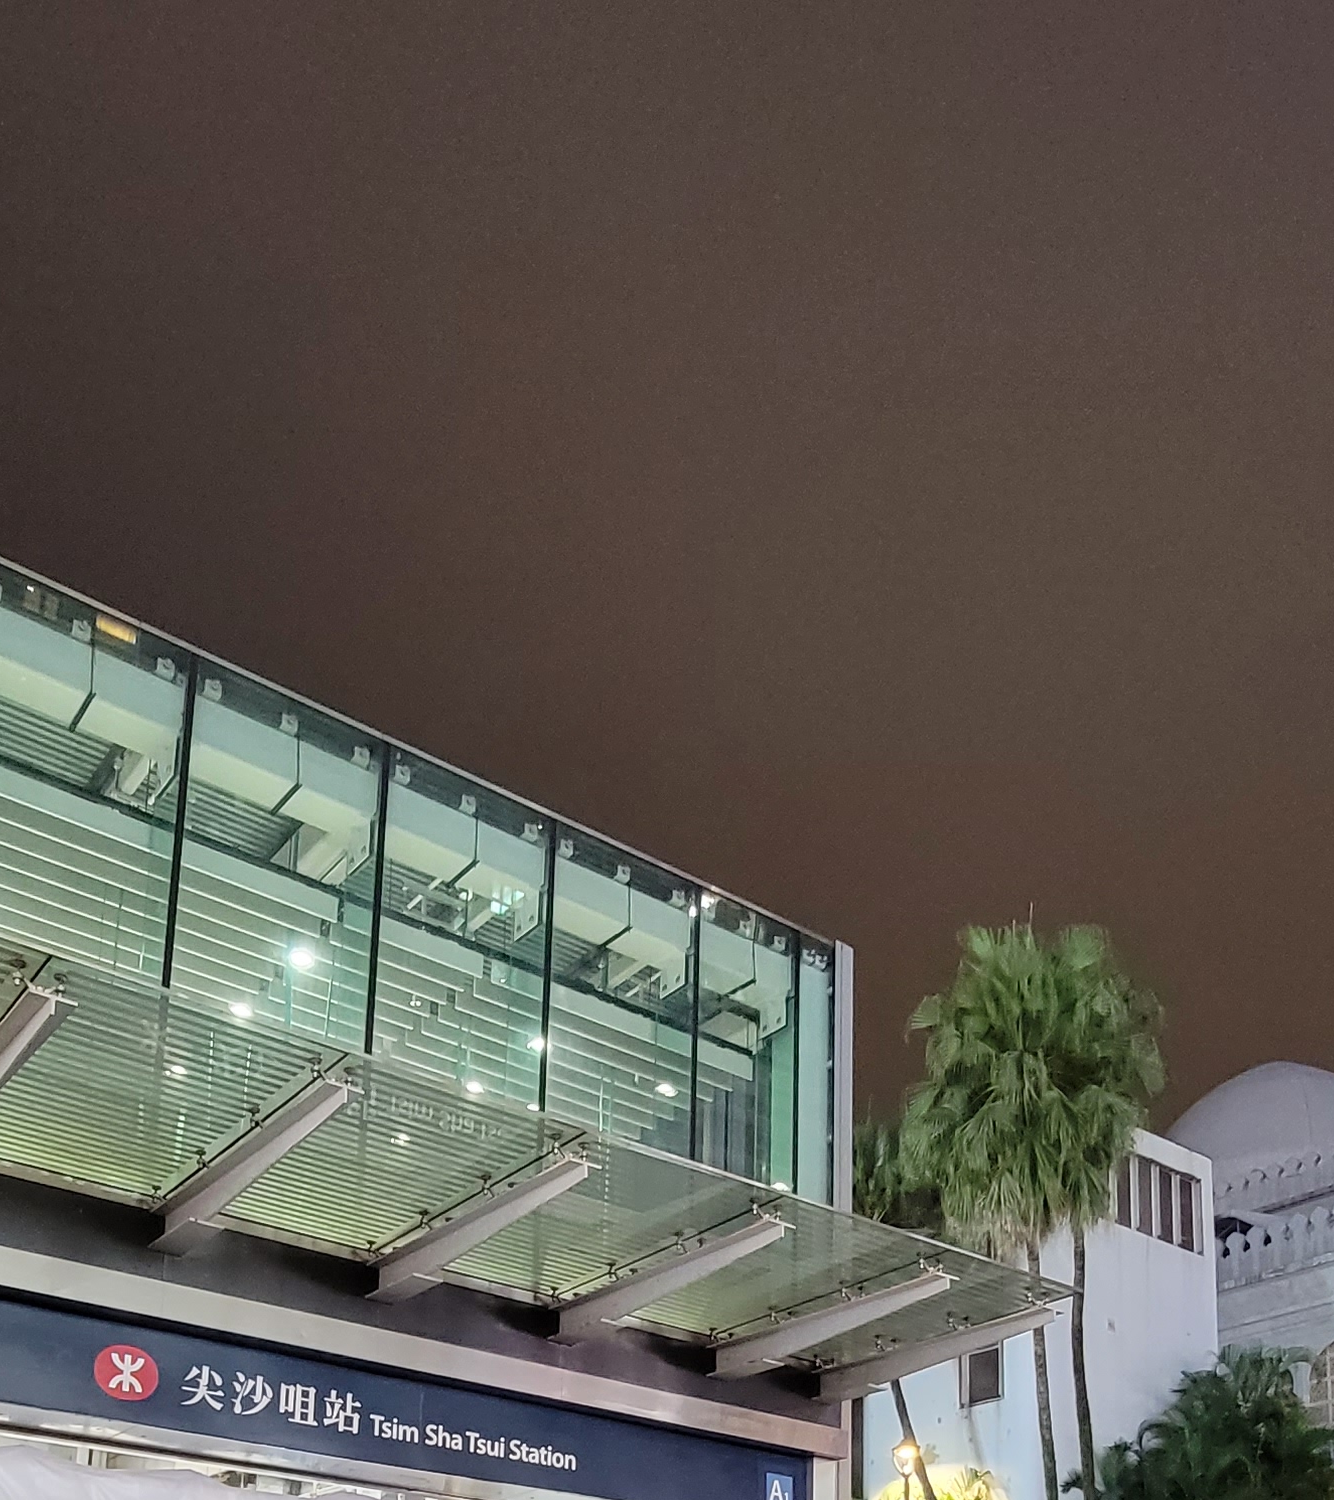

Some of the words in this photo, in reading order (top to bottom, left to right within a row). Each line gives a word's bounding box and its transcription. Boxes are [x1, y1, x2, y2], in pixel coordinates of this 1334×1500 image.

[180, 1364, 363, 1435] 尖沙咀站
[369, 1413, 420, 1444] Tsim
[424, 1424, 464, 1452] Sha
[465, 1430, 507, 1459] Tsui
[509, 1440, 578, 1472] Station
